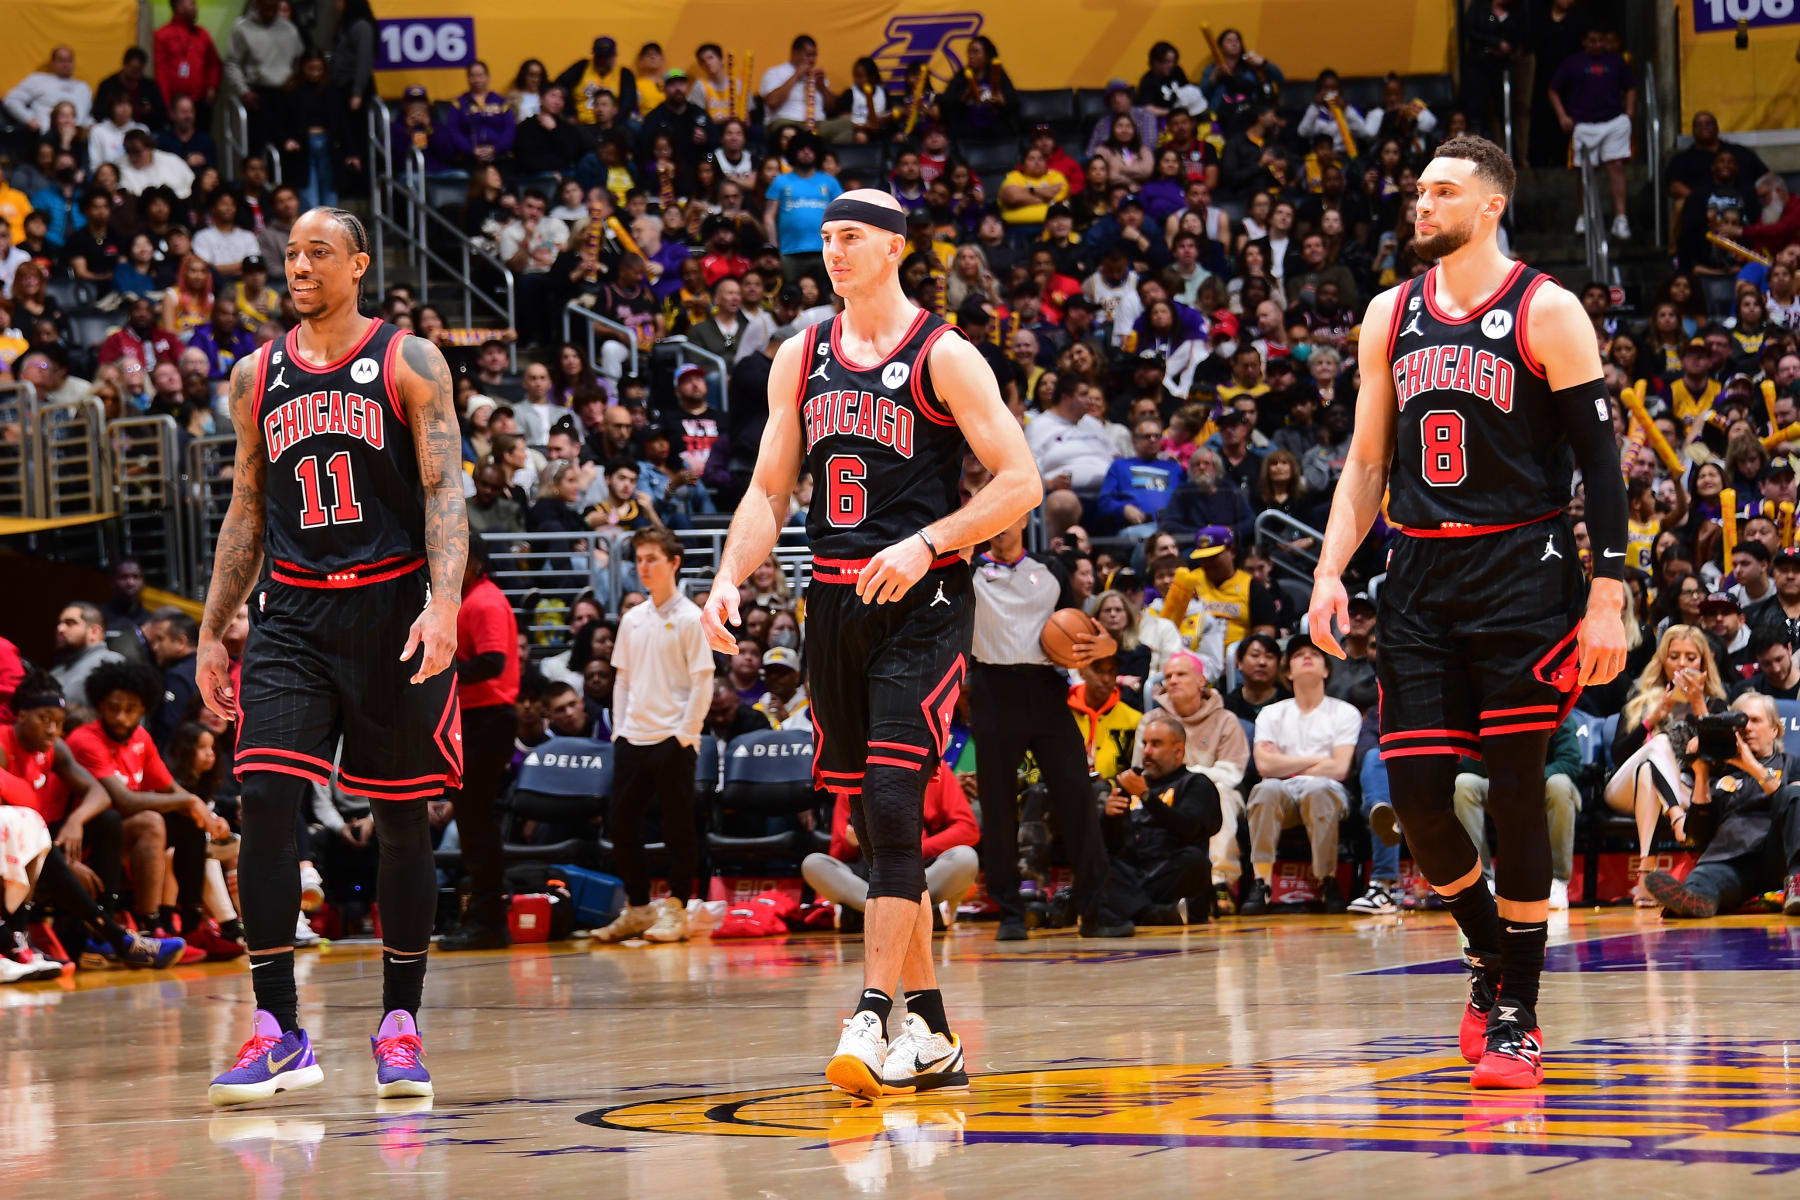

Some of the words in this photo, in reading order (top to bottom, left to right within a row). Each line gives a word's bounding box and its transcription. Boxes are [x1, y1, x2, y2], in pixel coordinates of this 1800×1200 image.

[381, 22, 468, 62] 106
[1409, 297, 1420, 311] 6
[272, 351, 283, 364] 6
[817, 342, 829, 355] 6
[1393, 345, 1515, 413] CHICAGO
[264, 391, 384, 463] CHICAGO
[803, 390, 914, 459] CHICAGO
[1420, 410, 1467, 486] 8
[295, 451, 363, 529] 11
[826, 454, 867, 528] 6
[543, 753, 603, 769] DELTA
[753, 743, 814, 757] DELTA
